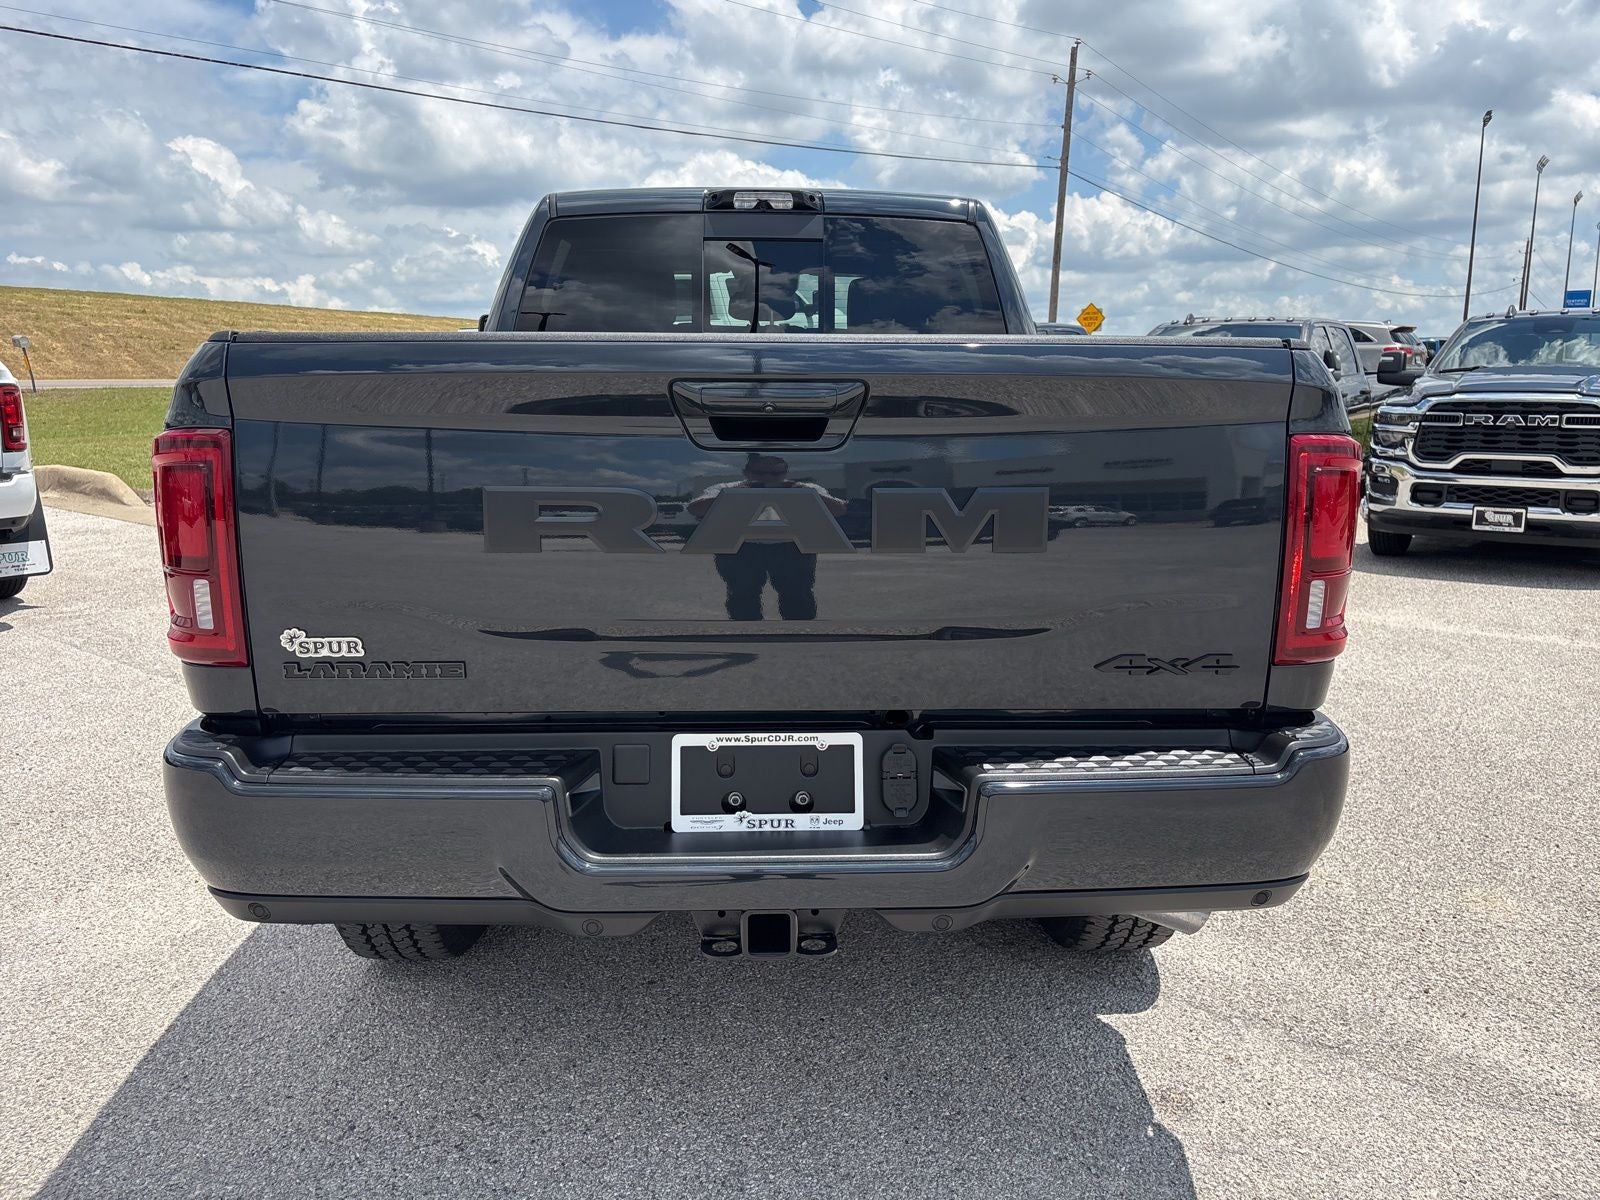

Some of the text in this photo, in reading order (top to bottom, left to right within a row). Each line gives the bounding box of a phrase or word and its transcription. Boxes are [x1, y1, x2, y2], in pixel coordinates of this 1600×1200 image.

[1464, 414, 1560, 427] RAM
[483, 486, 1050, 554] RAM
[298, 640, 361, 655] SPUR
[283, 661, 467, 679] LARAMIE
[715, 734, 819, 745] www.SpurCDJR.com
[746, 818, 796, 829] SPUR
[822, 817, 844, 826] Jeep
